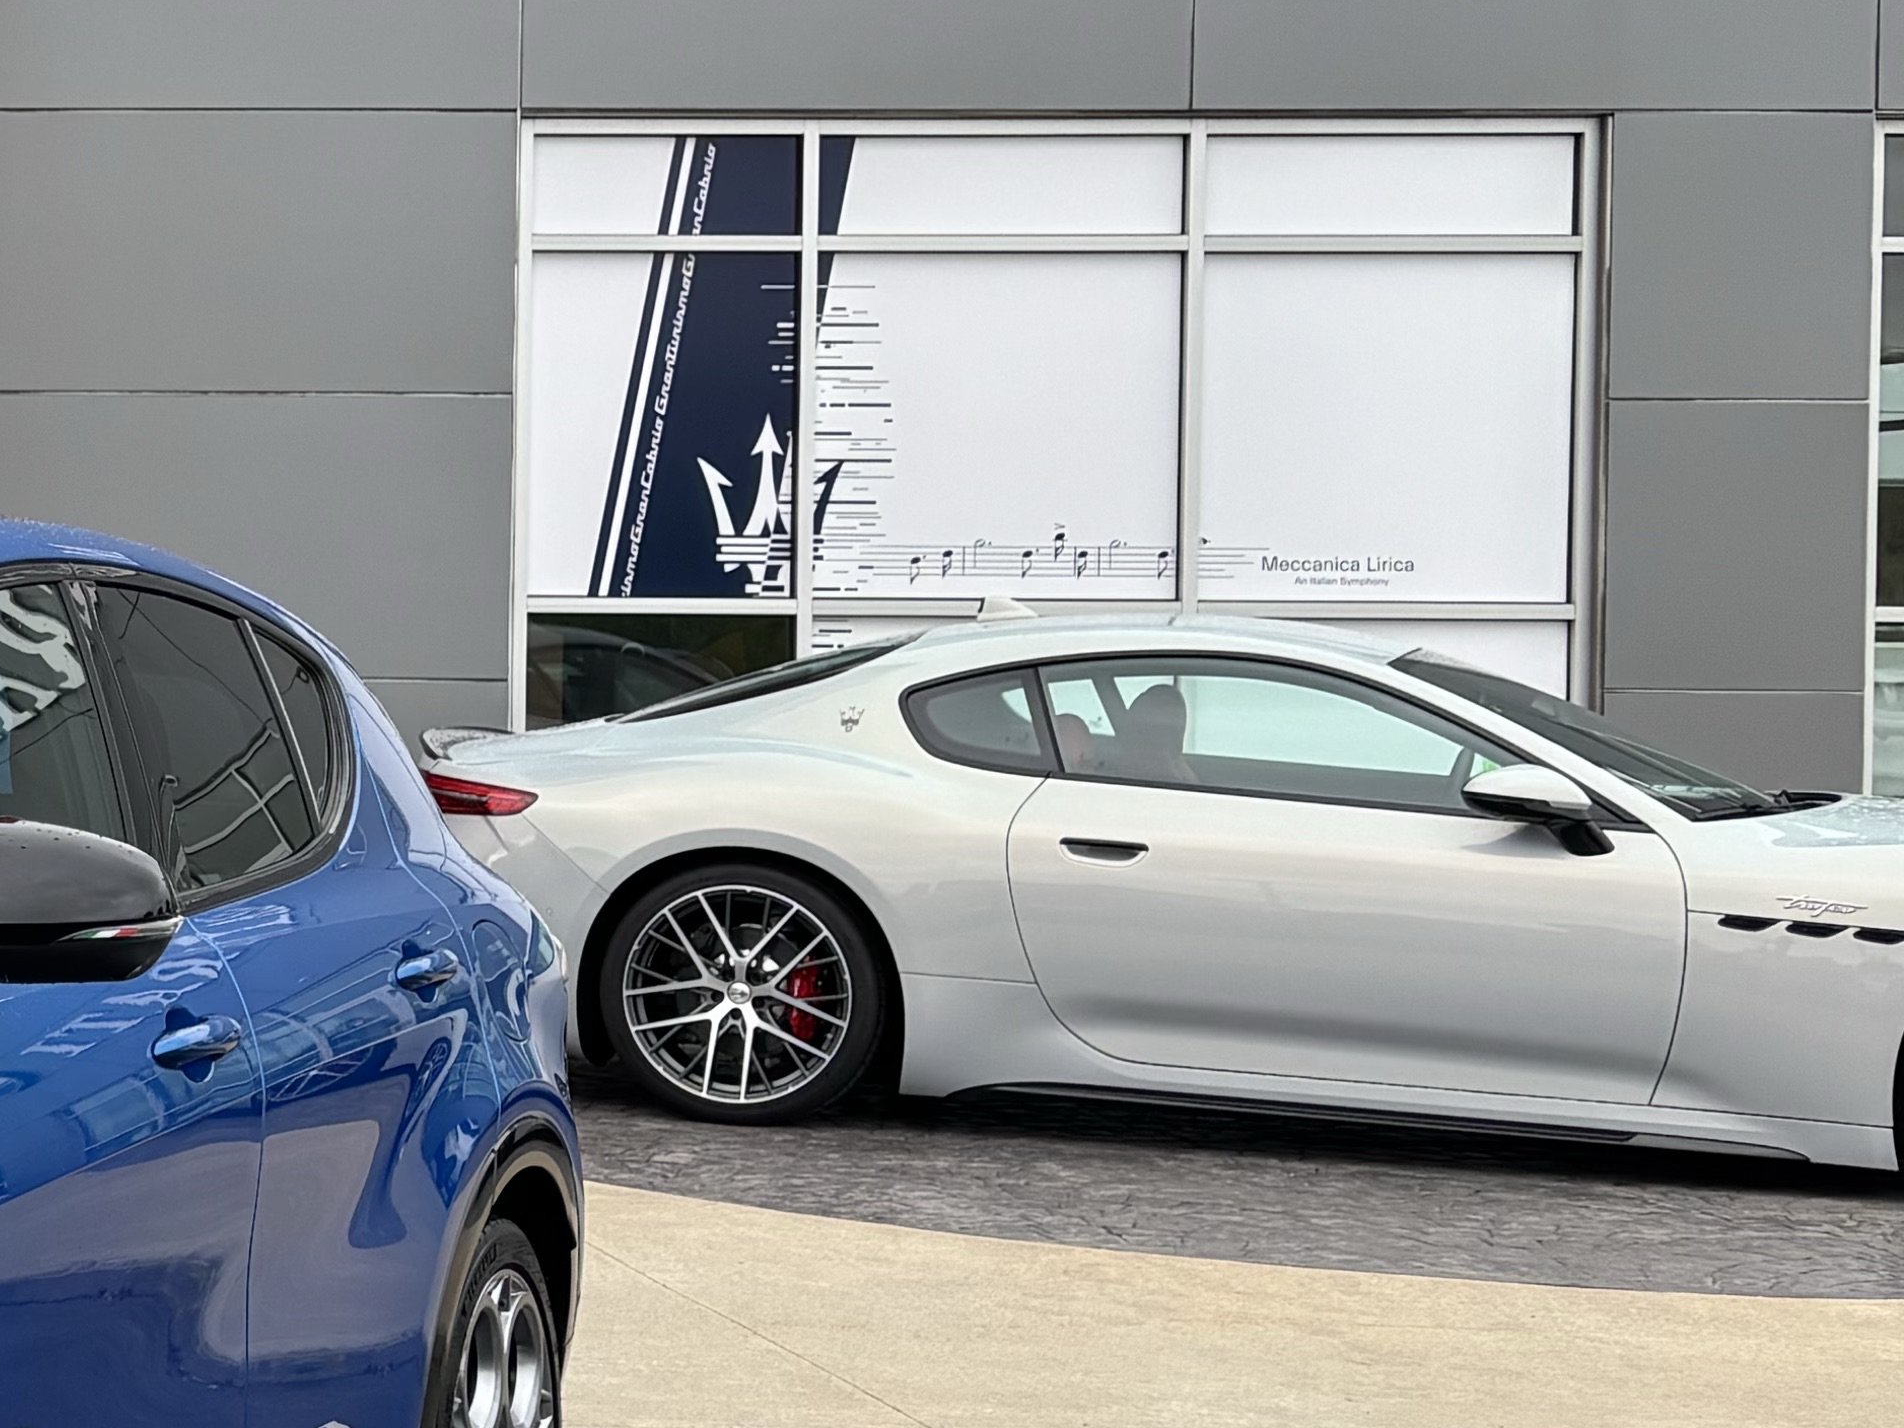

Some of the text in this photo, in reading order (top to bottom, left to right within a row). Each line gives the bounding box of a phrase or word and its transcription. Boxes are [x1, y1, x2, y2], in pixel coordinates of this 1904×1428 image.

[1261, 556, 1415, 572] Meccanica Lirica
[1310, 576, 1338, 586] Italian
[1340, 576, 1389, 587] Symphony
